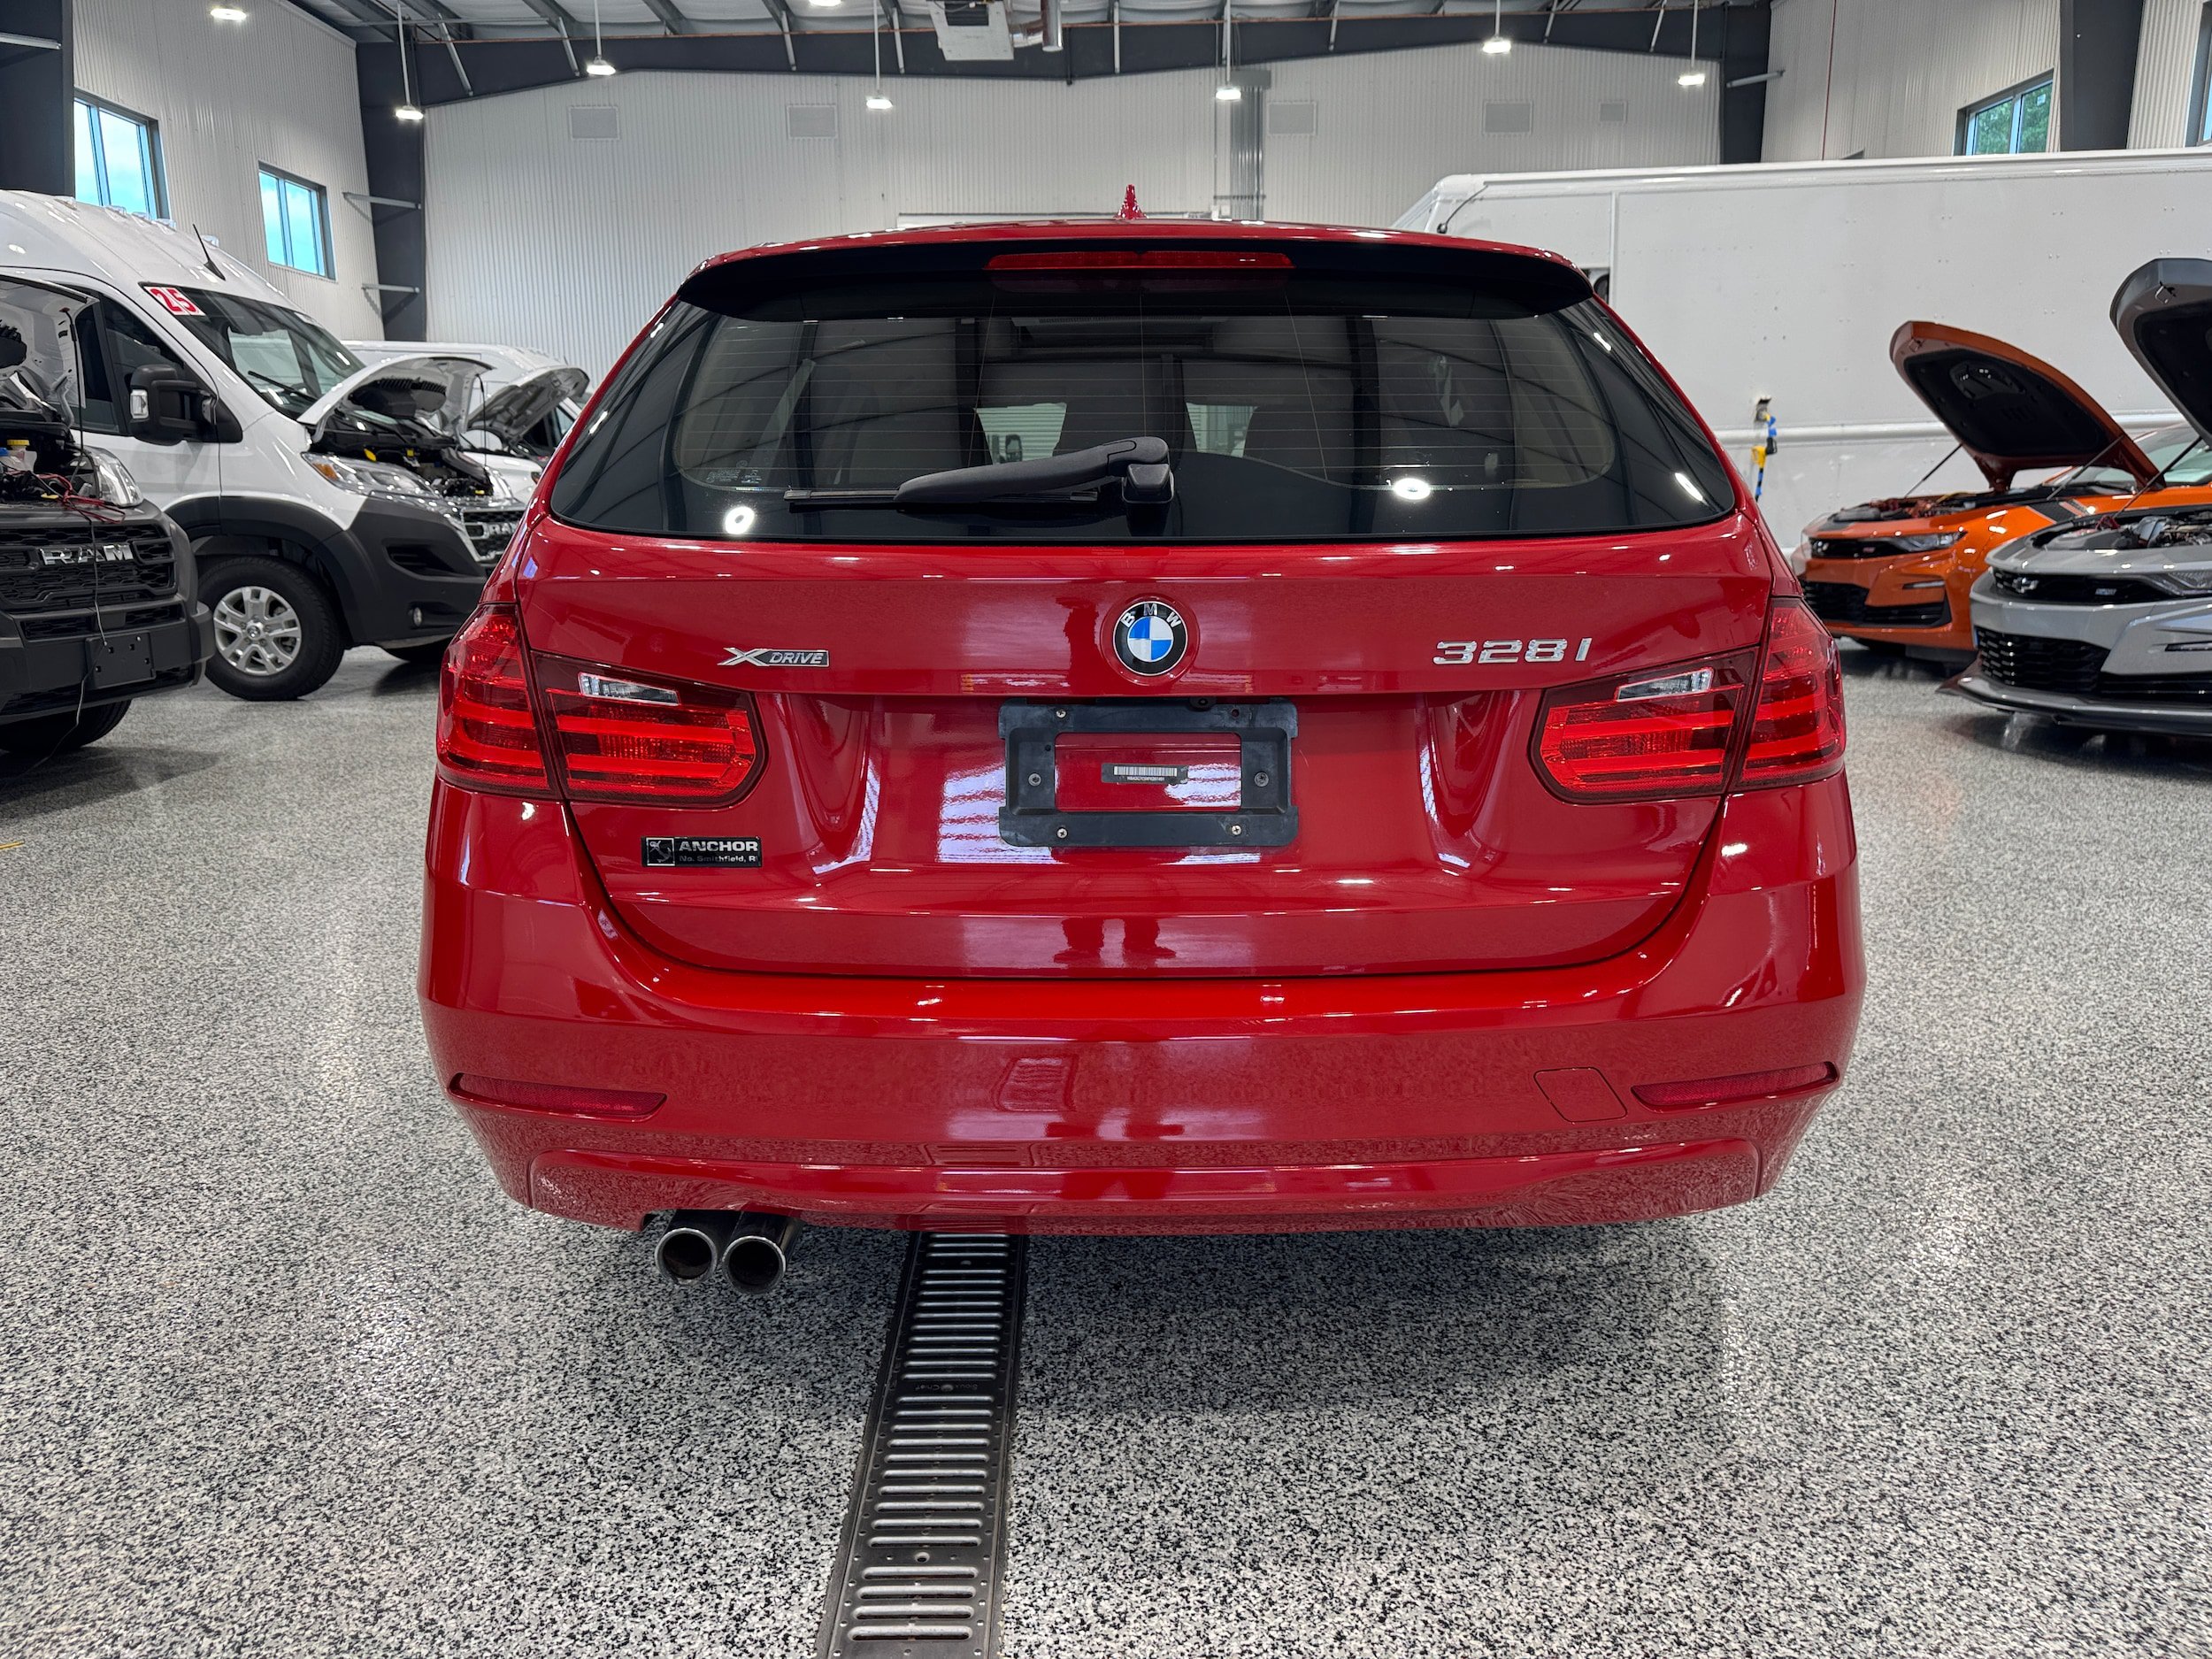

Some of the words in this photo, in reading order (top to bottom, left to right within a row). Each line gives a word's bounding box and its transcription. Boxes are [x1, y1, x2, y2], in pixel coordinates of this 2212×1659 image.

[149, 288, 197, 312] 25
[40, 543, 134, 565] RAM
[1120, 603, 1182, 628] BMW
[679, 841, 758, 852] ANCHOR
